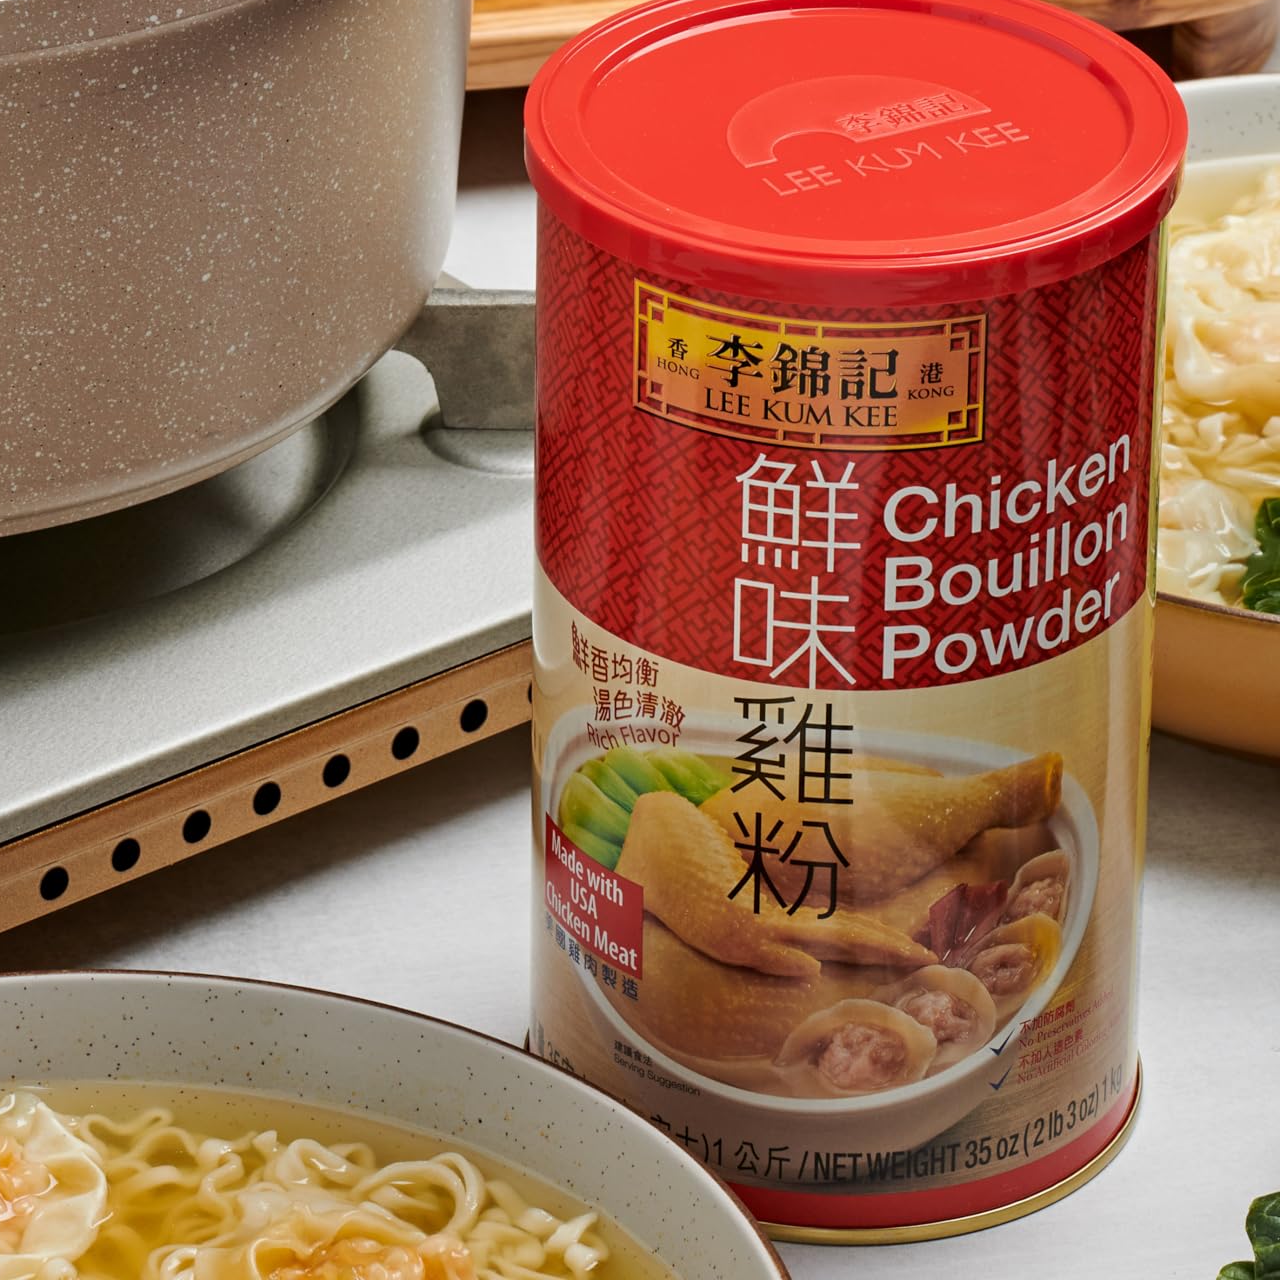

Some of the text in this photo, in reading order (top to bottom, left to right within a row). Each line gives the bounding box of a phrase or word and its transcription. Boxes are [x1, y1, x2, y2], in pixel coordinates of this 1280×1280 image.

[838, 92, 970, 133] 李錦記
[762, 121, 1030, 196] LEE KUM KEE
[657, 356, 700, 381] HONG
[667, 338, 689, 361] 香
[705, 332, 899, 401] 李錦記
[920, 362, 944, 385] 港
[704, 387, 898, 428] LEE KUM KEE
[908, 385, 955, 401] KONG
[883, 433, 1130, 543] Chicken
[884, 502, 1127, 612] Bouillon
[571, 620, 659, 687] 鮮香均衡
[882, 572, 1120, 680] Powder
[728, 453, 861, 920] 鮮味雞粉
[587, 722, 680, 750] Rich Flavor
[551, 829, 624, 906] Made with
[546, 880, 638, 970] Chicken Meat
[570, 878, 598, 919] USA
[1018, 1038, 1034, 1049] No
[613, 1053, 701, 1096] Serving Suggestion
[815, 1151, 864, 1182] NET
[866, 1141, 961, 1179] WEIGHT
[964, 1136, 992, 1169] 35
[996, 1132, 1020, 1159] oz
[1048, 1109, 1063, 1140] lb
[1066, 1100, 1077, 1130] 3
